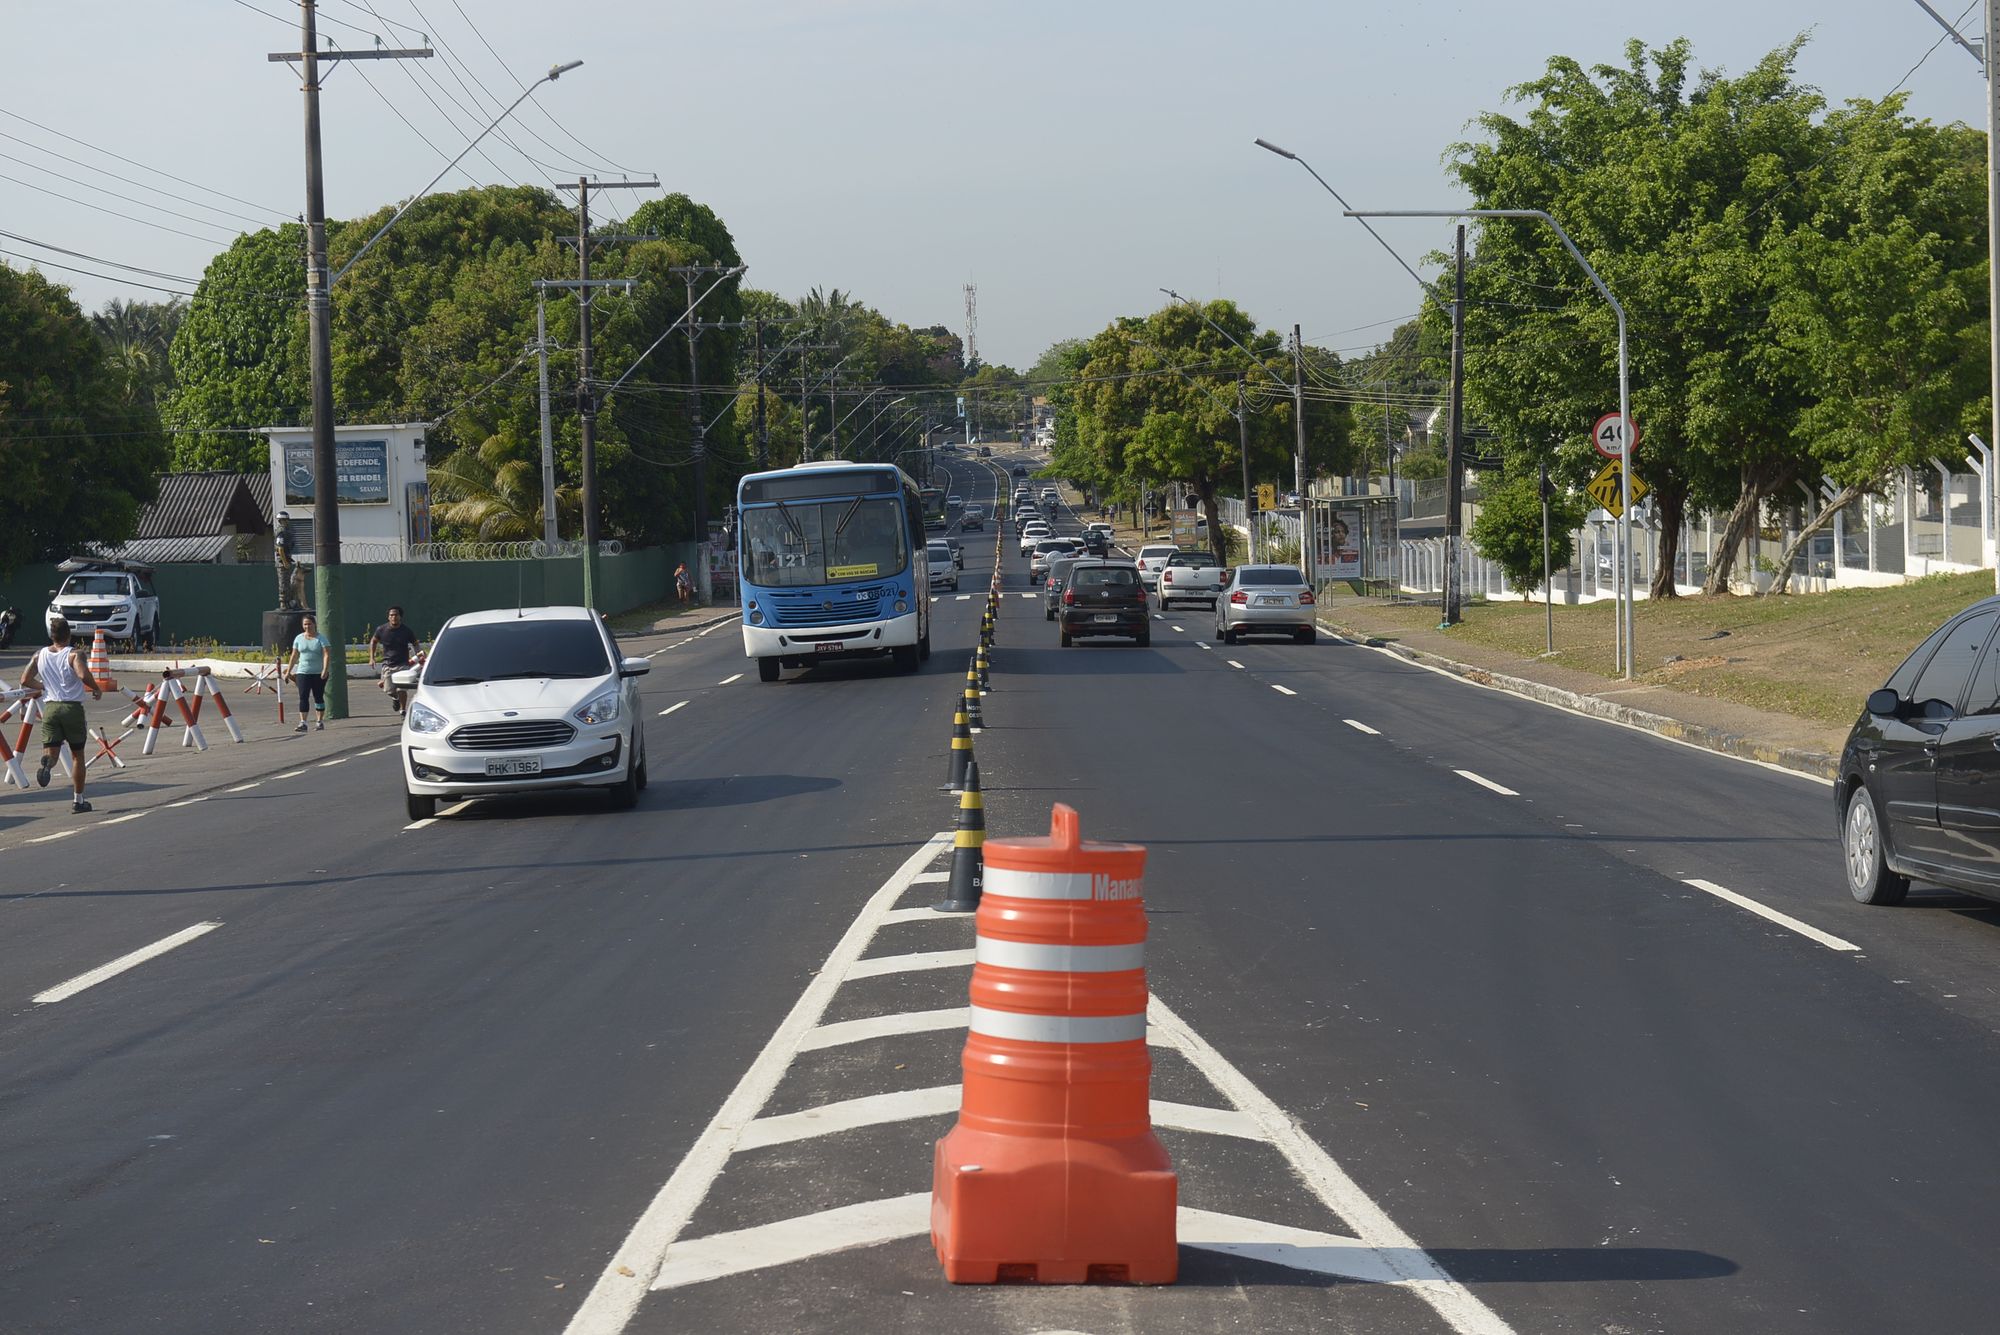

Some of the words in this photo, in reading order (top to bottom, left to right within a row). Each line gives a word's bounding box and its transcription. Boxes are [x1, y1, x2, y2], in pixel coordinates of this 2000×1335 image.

[343, 458, 381, 466] DEFENDE,
[349, 474, 381, 482] RENDE!
[776, 554, 806, 568] 121
[488, 763, 508, 775] PHK
[513, 761, 539, 773] 1962
